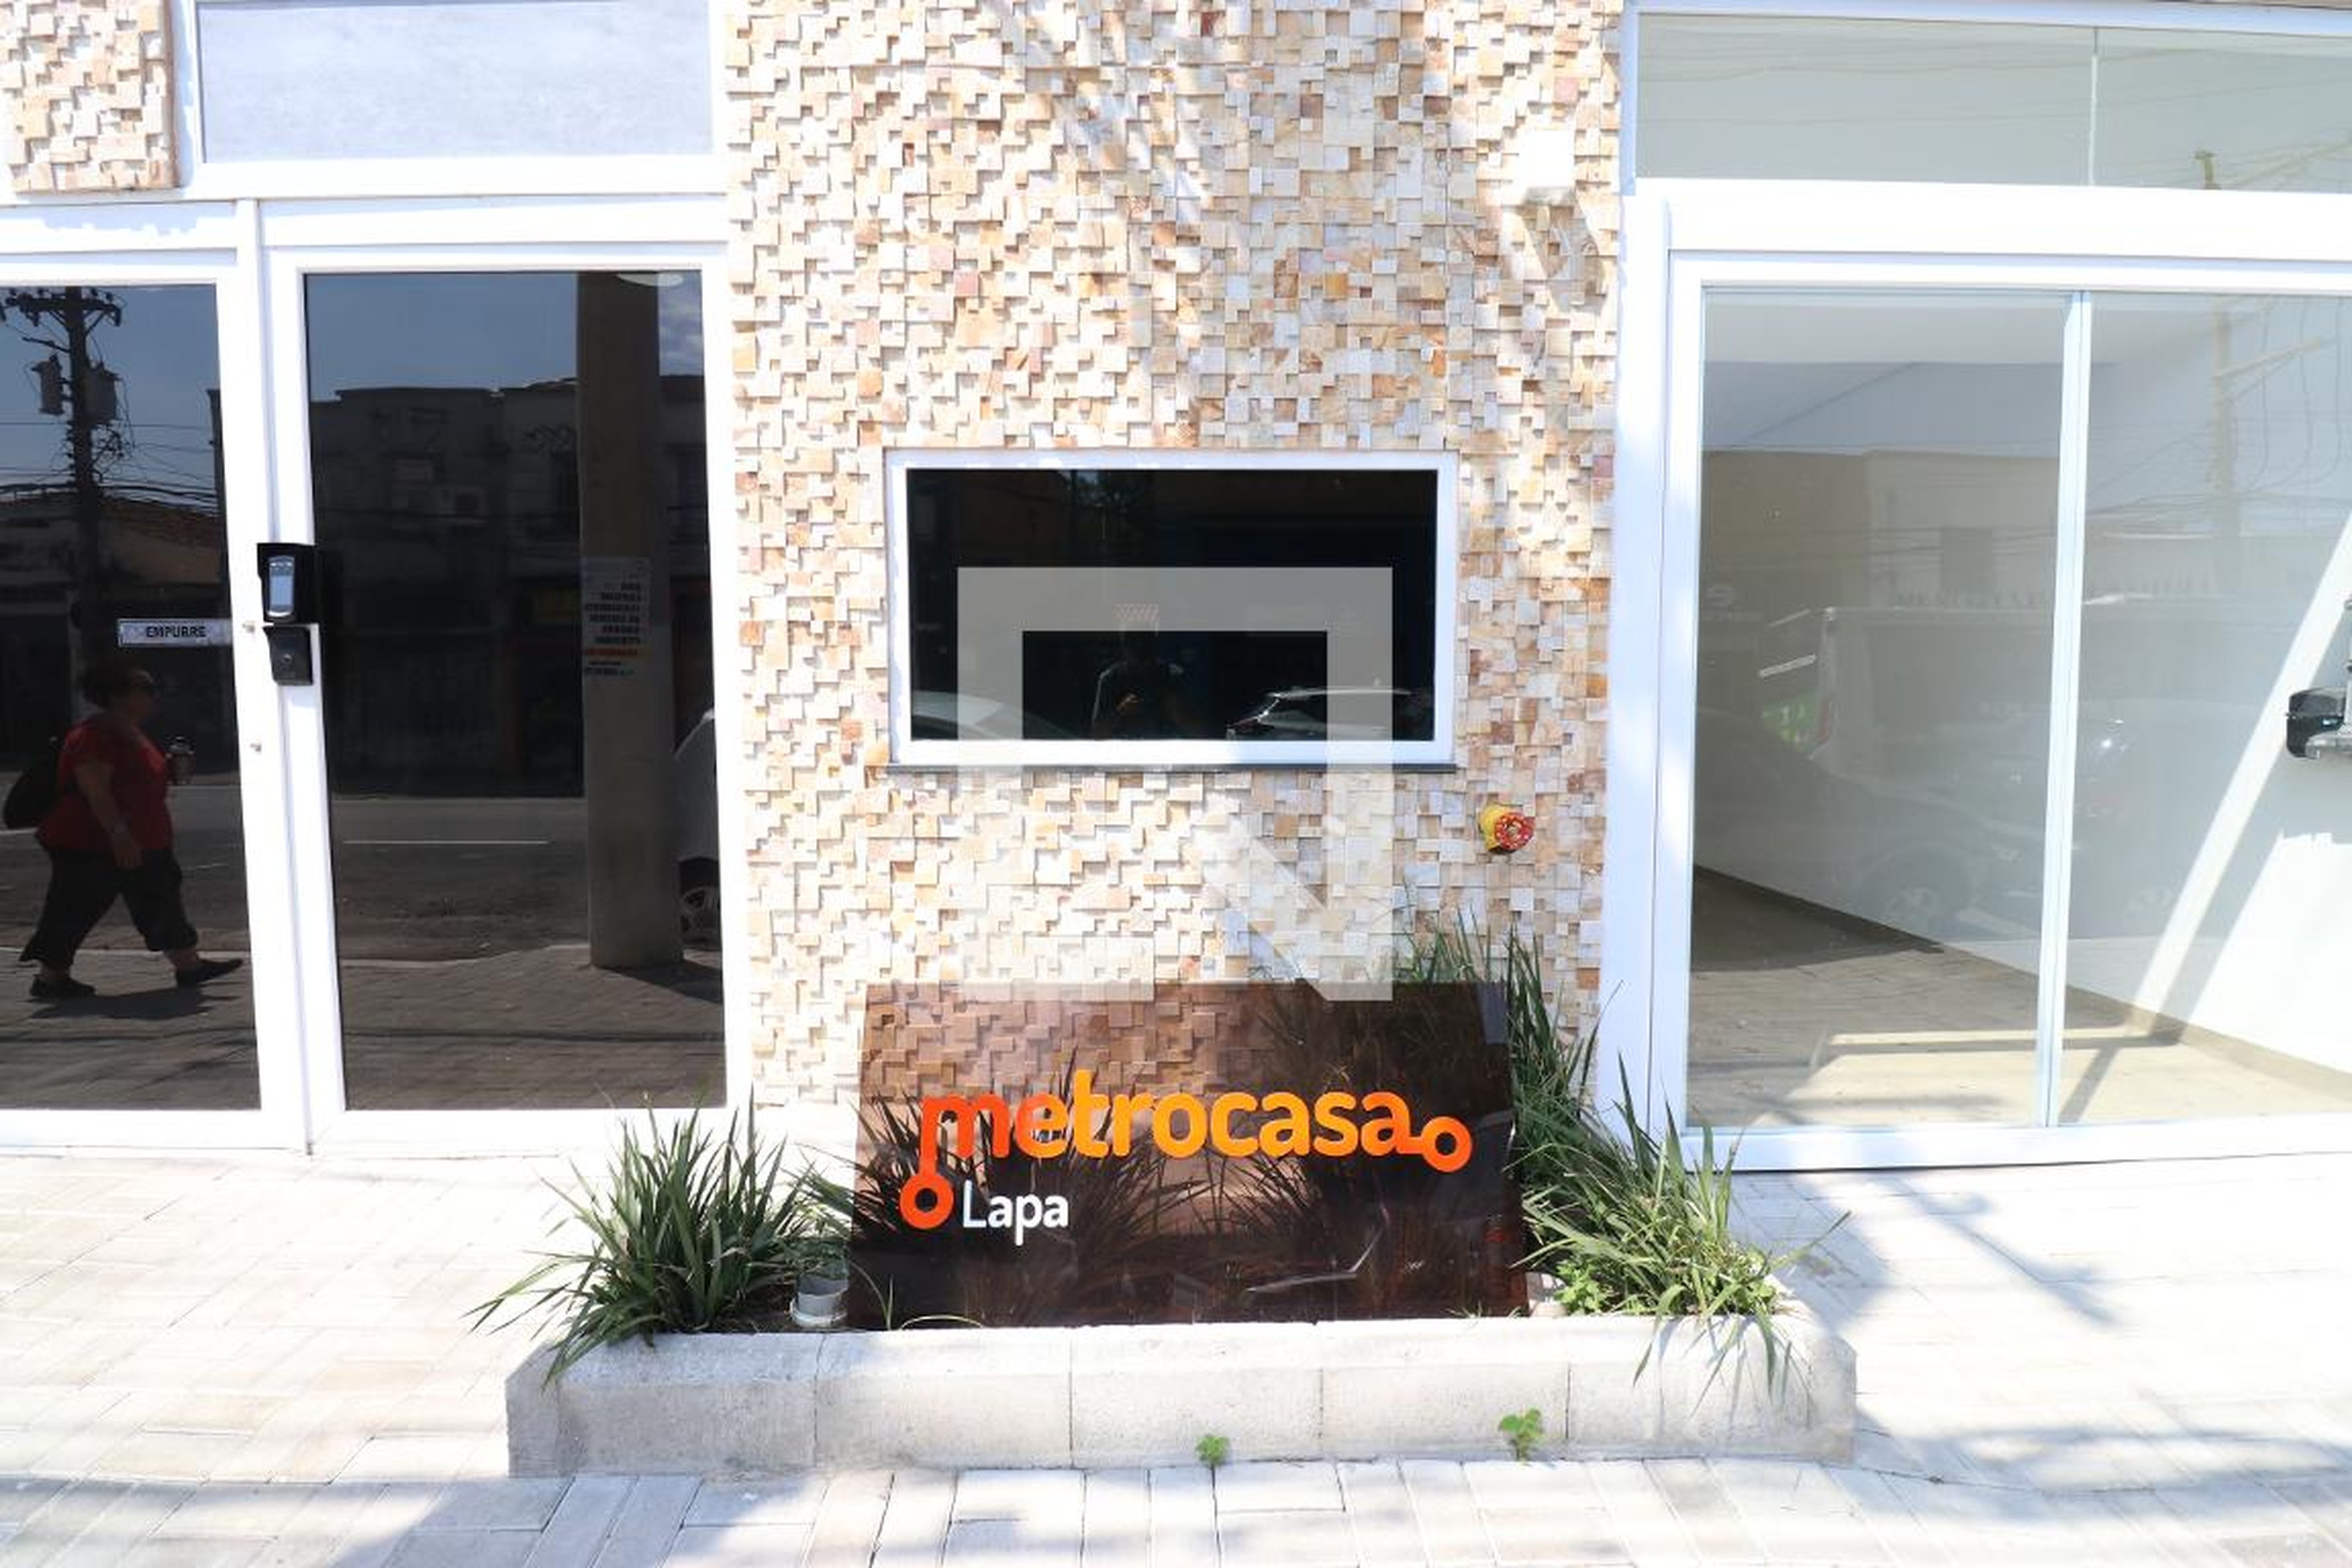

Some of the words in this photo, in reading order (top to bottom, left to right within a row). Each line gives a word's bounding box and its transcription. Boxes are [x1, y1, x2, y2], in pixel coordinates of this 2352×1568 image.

[146, 626, 206, 638] EMPURRE
[919, 1069, 1472, 1176] metrocasa
[962, 1180, 1069, 1245] Lapa
